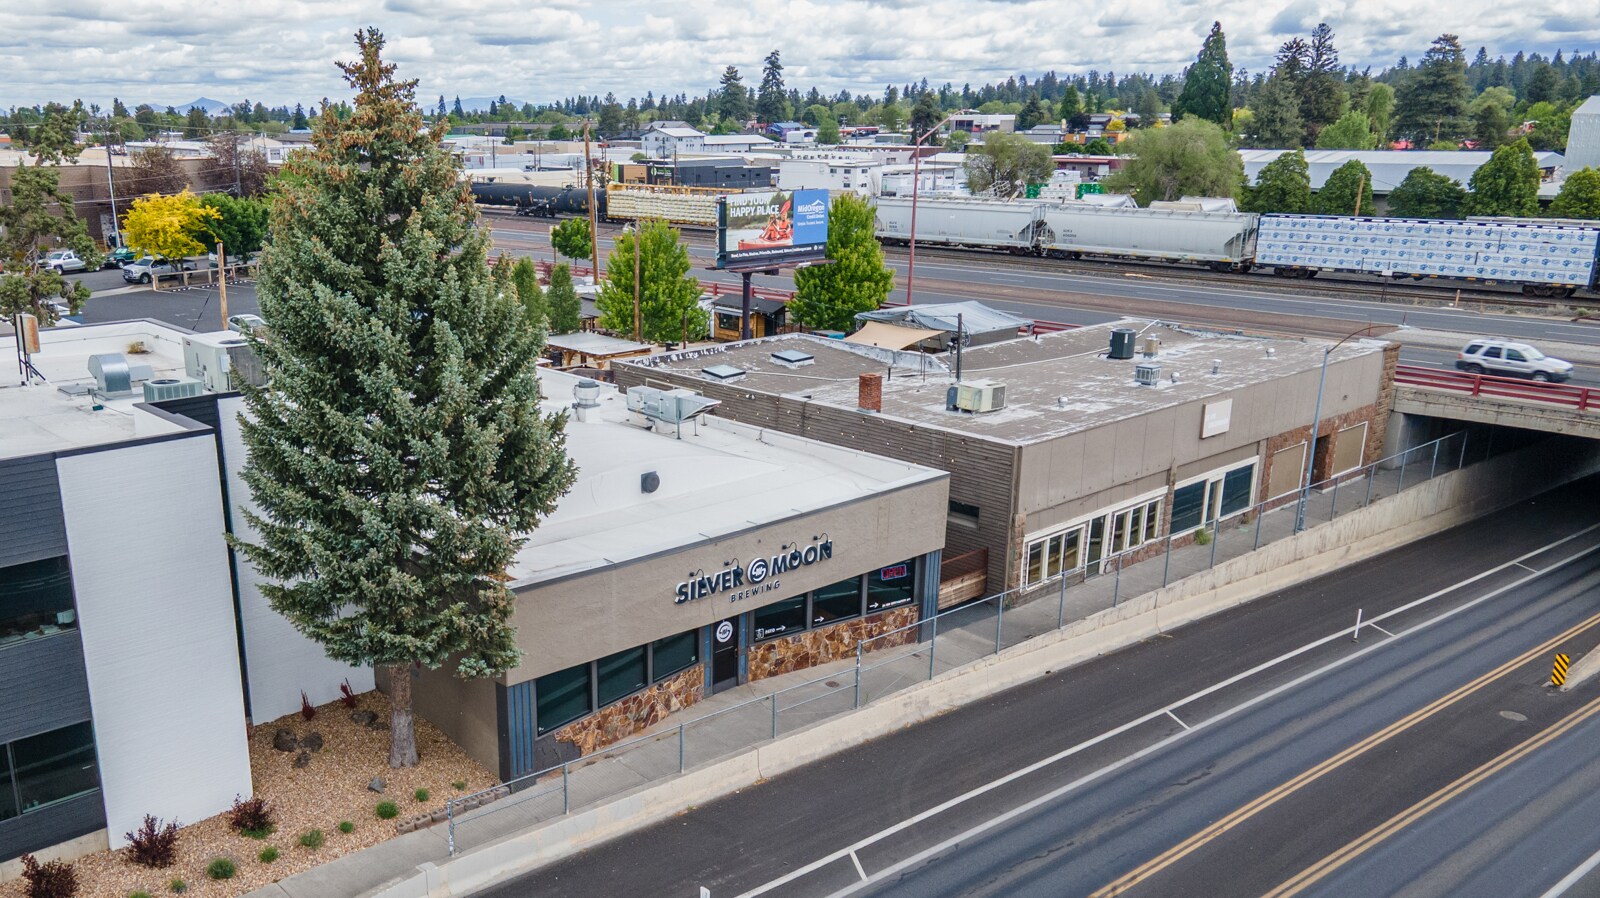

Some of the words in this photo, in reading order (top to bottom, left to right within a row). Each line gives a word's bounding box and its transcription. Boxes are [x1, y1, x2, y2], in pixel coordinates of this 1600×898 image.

[730, 206, 755, 217] HAPPY
[757, 204, 779, 215] PLACE
[675, 567, 743, 604] SILVER
[769, 540, 832, 576] MOON
[730, 580, 780, 603] BREWING
